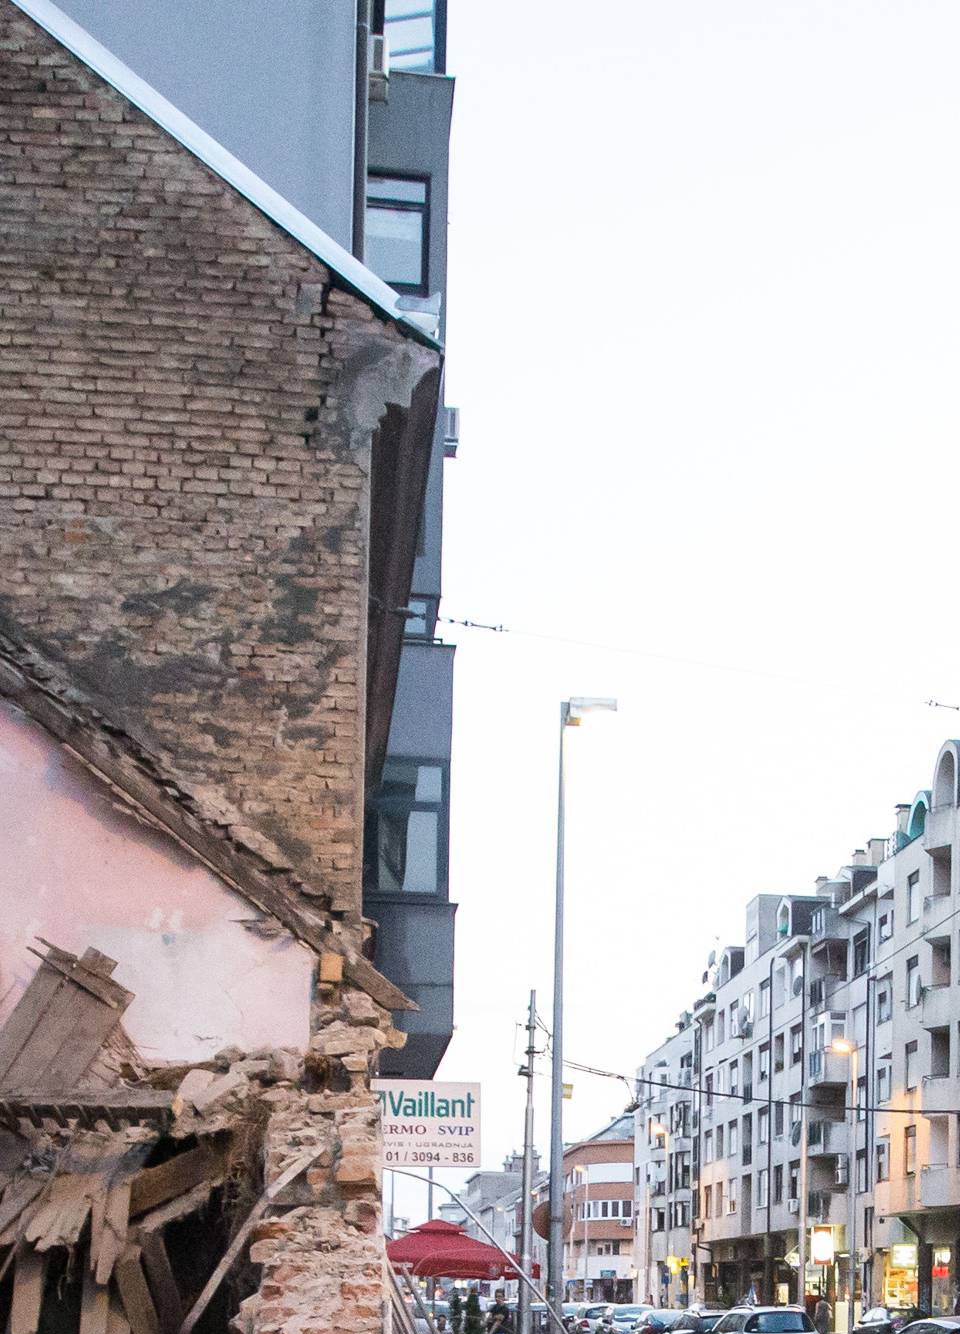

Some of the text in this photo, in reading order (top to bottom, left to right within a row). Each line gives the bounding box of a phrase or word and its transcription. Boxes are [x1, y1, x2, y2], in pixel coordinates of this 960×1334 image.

[388, 1090, 475, 1118] Vaillant
[437, 1124, 475, 1137] SVIP
[385, 1151, 399, 1162] 01
[411, 1152, 441, 1162] 3094
[452, 1153, 475, 1163] 836
